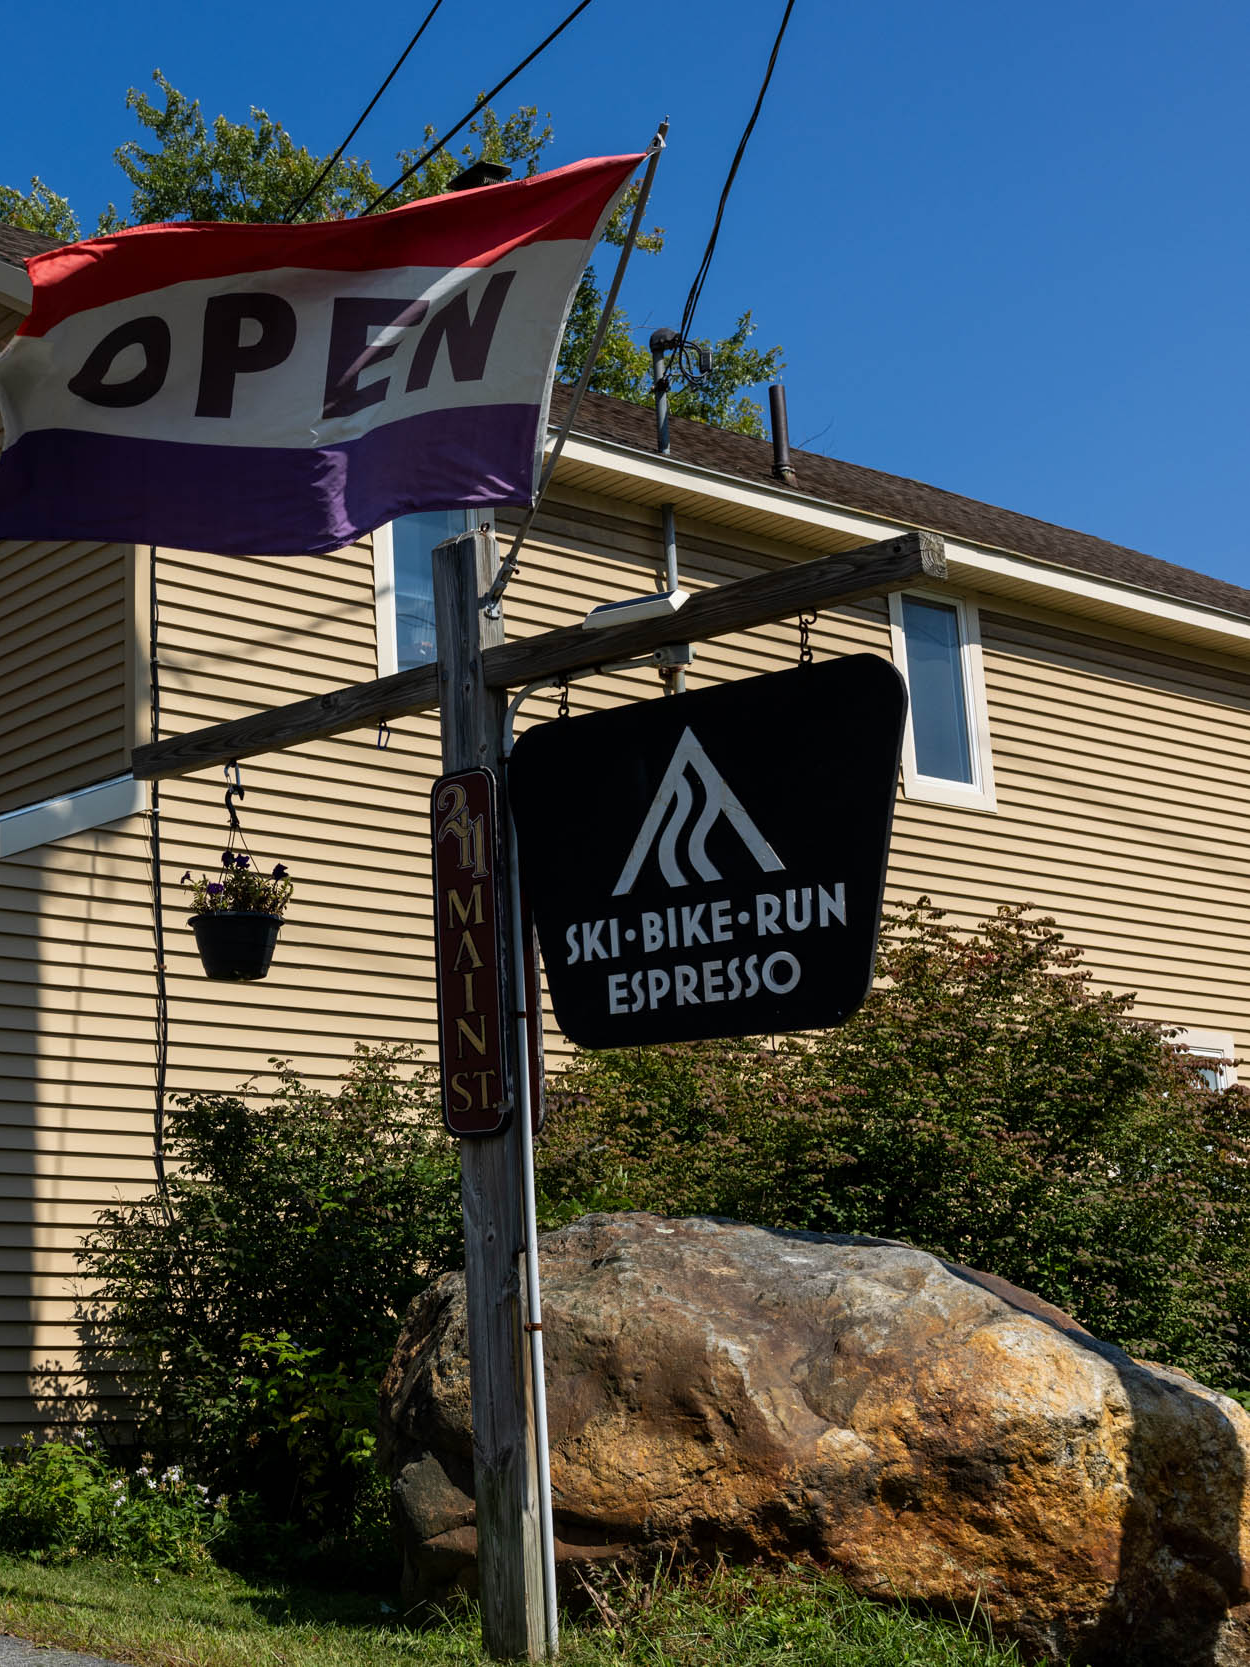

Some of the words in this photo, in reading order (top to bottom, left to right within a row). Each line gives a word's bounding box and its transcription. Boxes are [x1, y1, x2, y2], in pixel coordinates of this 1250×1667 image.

[67, 269, 517, 421] OPEN
[565, 917, 621, 965] SKI
[642, 899, 734, 953] BIKE
[755, 882, 847, 937] RUN
[446, 883, 487, 1060] MAIN
[607, 950, 802, 1015] ESPRESSO
[451, 1069, 499, 1113] ST.
